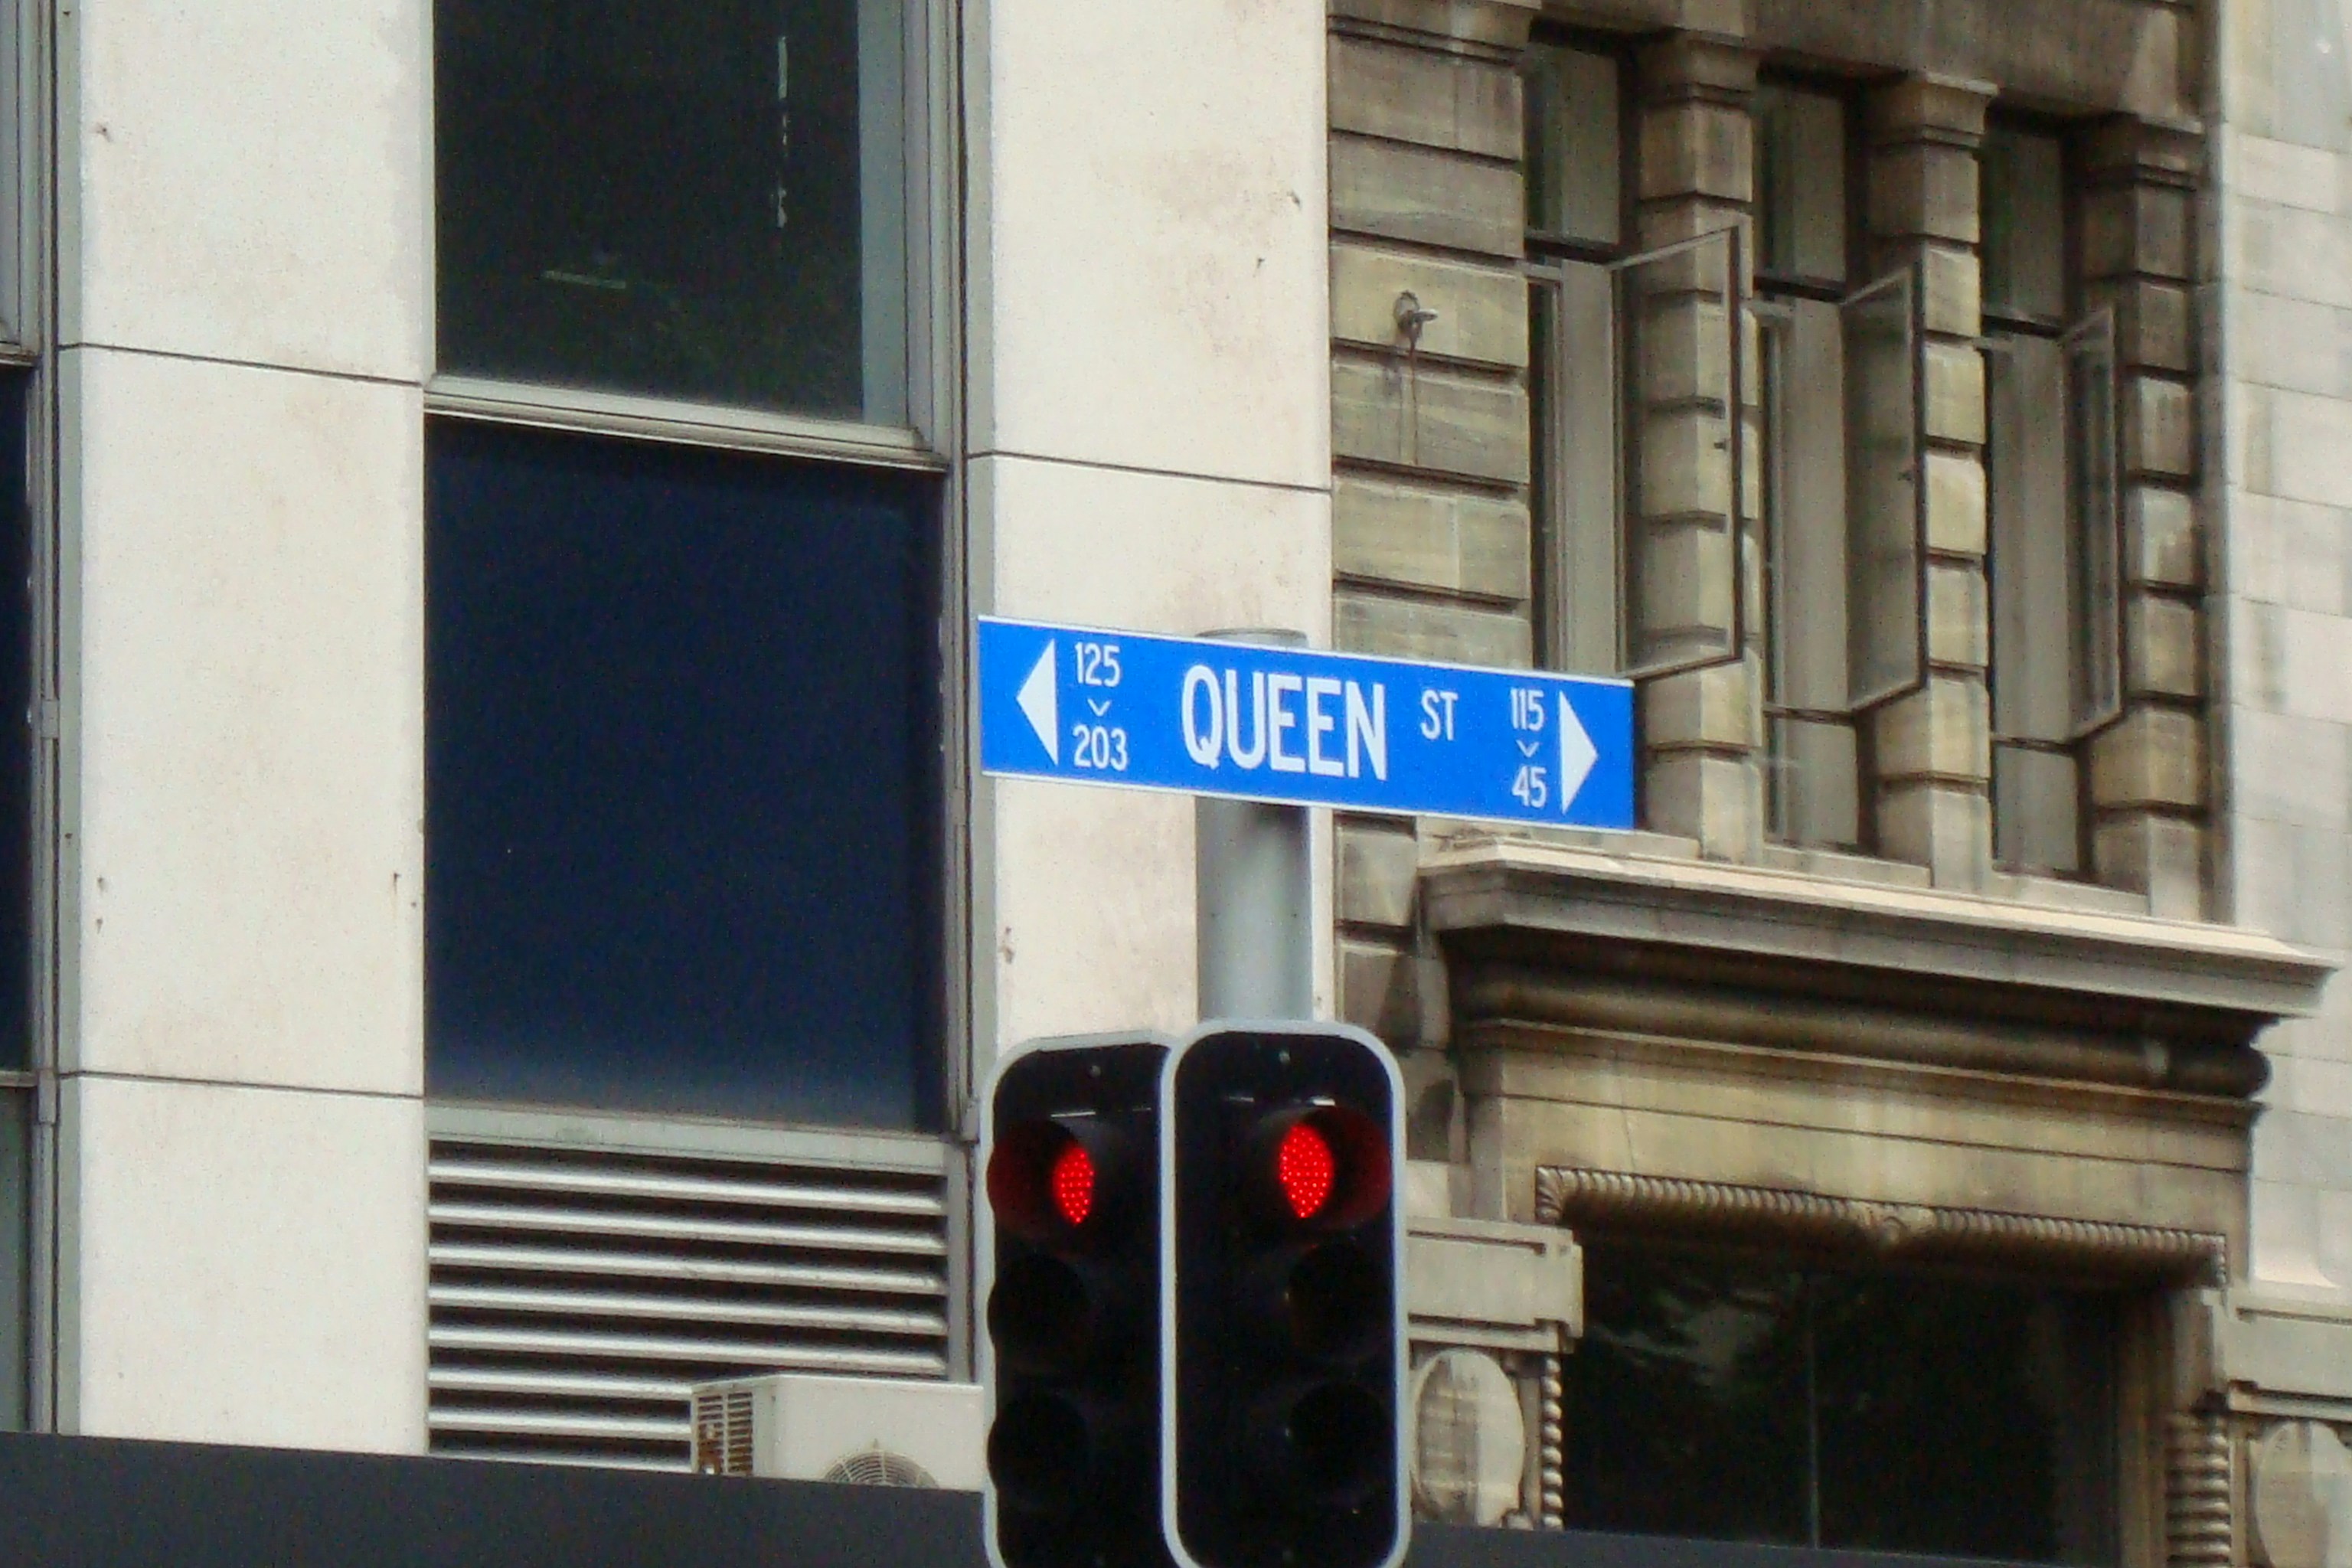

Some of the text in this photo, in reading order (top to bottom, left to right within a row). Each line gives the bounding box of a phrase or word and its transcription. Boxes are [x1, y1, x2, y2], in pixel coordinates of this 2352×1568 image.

[1075, 642, 1121, 688] 125
[1181, 664, 1459, 782] QUEEN ST
[1511, 688, 1545, 732] 115
[1073, 724, 1129, 772] 203
[1511, 765, 1547, 808] 45
